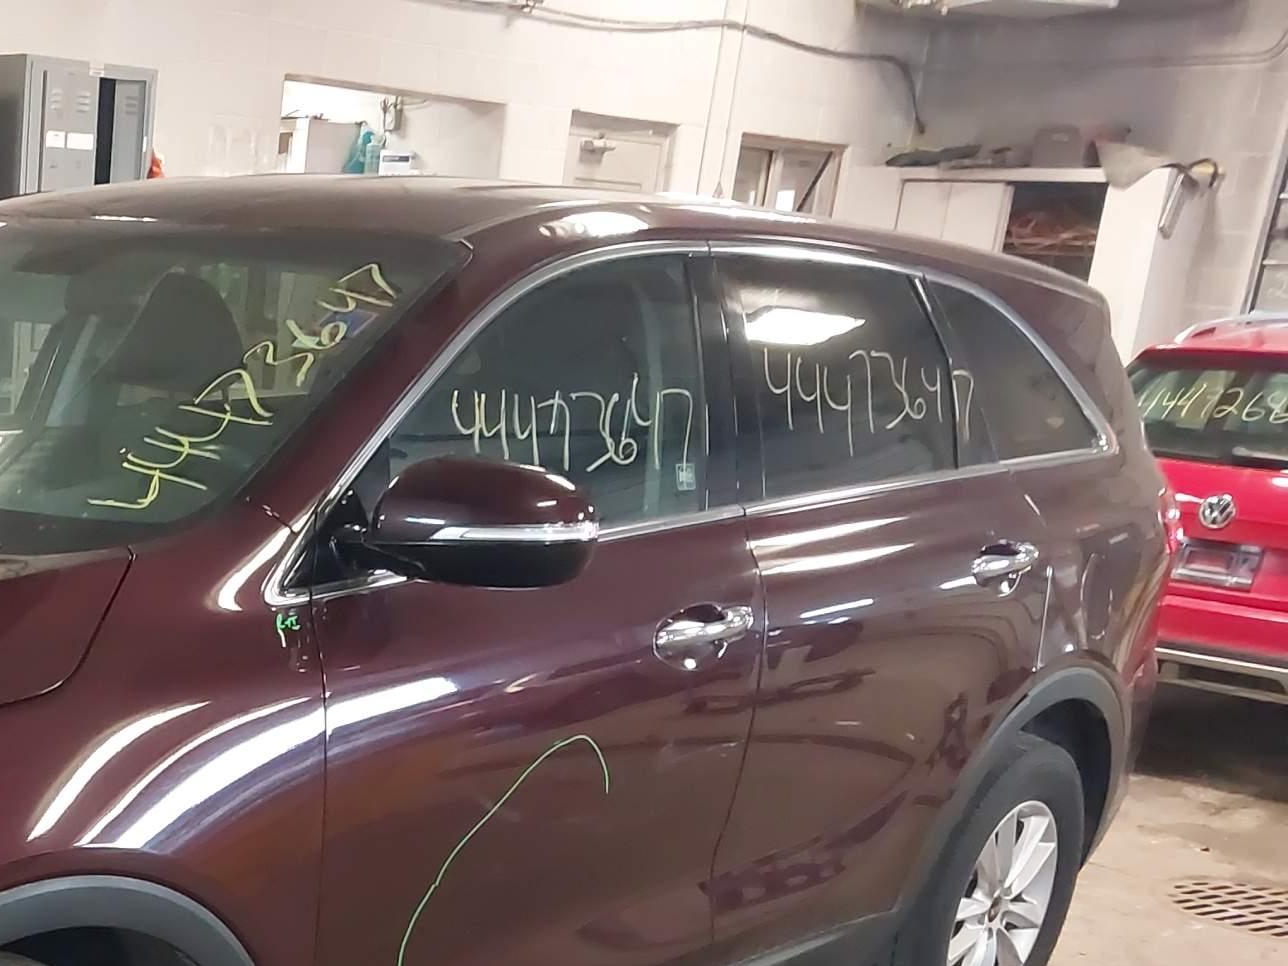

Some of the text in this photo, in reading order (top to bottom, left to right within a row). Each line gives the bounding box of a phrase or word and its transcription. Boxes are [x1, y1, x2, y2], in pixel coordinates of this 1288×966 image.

[85, 263, 397, 509] 44473647
[452, 373, 694, 471] 44473647
[764, 347, 974, 457] 44473647
